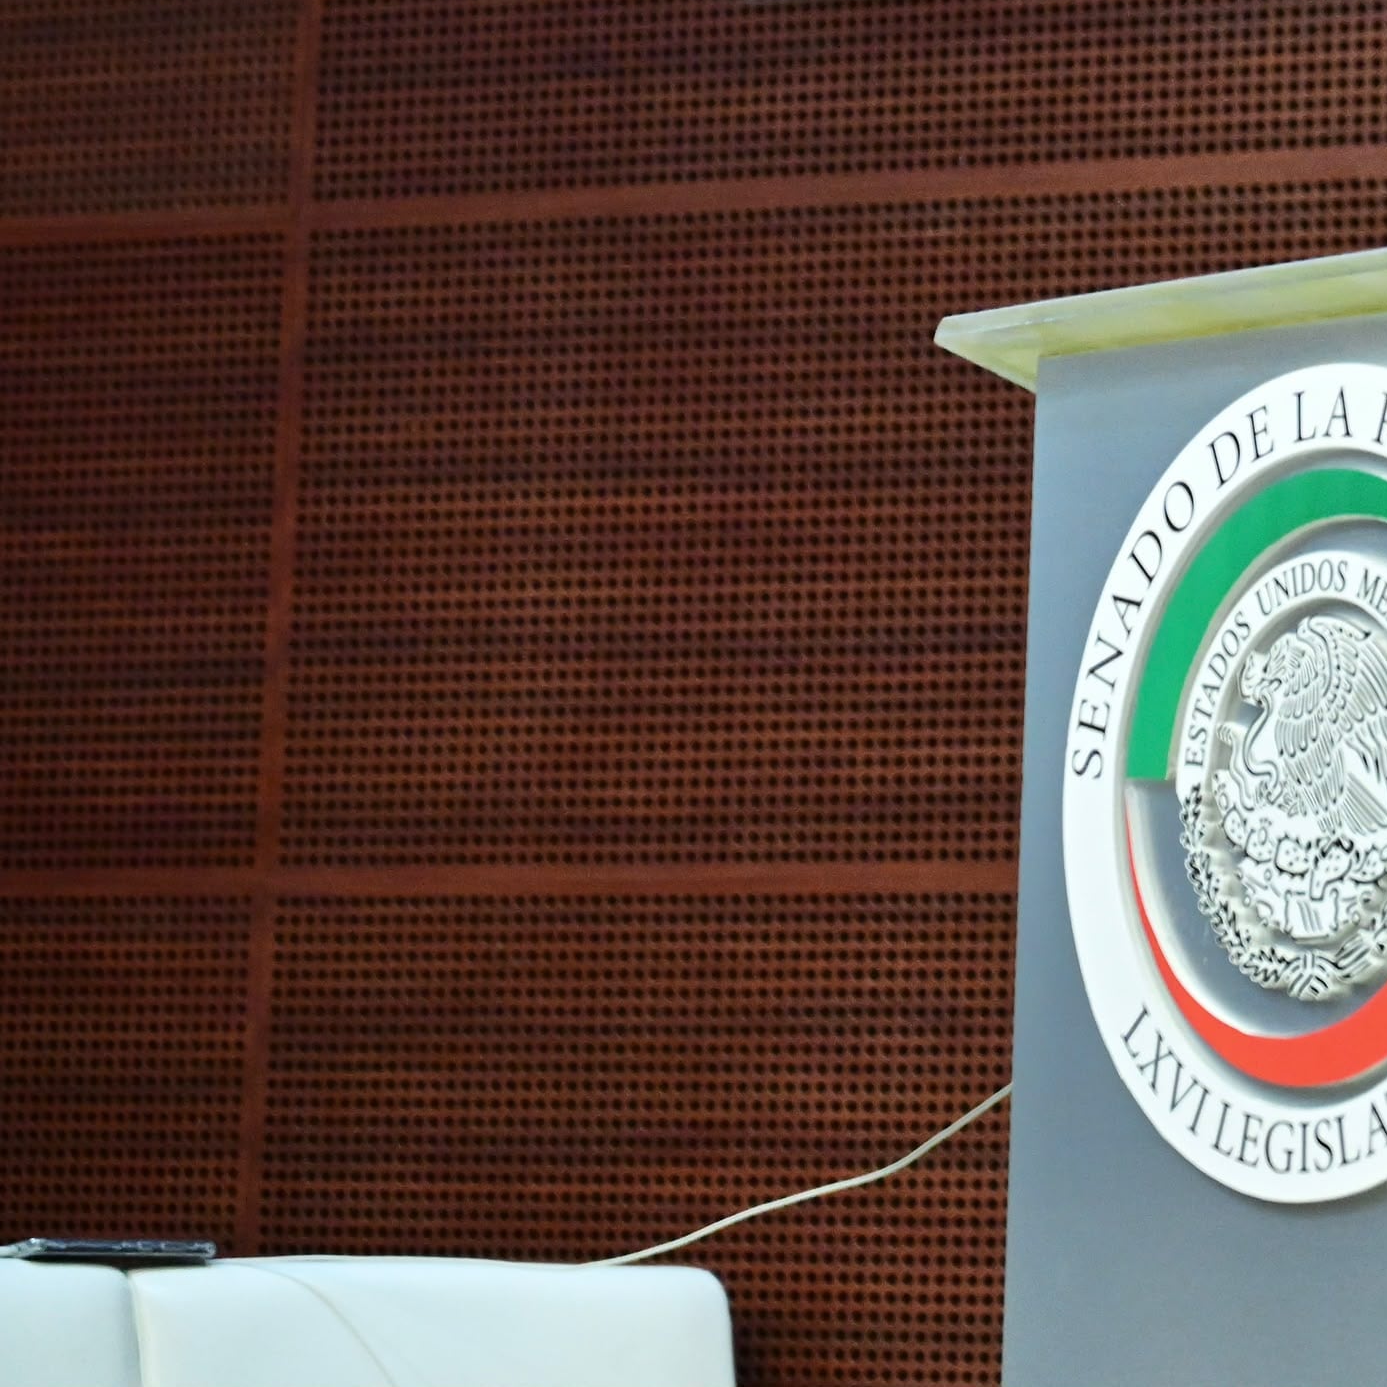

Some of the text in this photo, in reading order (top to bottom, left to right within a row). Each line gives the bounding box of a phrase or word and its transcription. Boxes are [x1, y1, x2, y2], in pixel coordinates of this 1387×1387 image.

[1072, 481, 1195, 779] SENADO
[1206, 405, 1274, 490] DE
[1293, 386, 1352, 443] LA
[1185, 612, 1251, 767] ESTADOS
[1255, 559, 1348, 616] UNIDOS
[1121, 1004, 1210, 1136] LXVI
